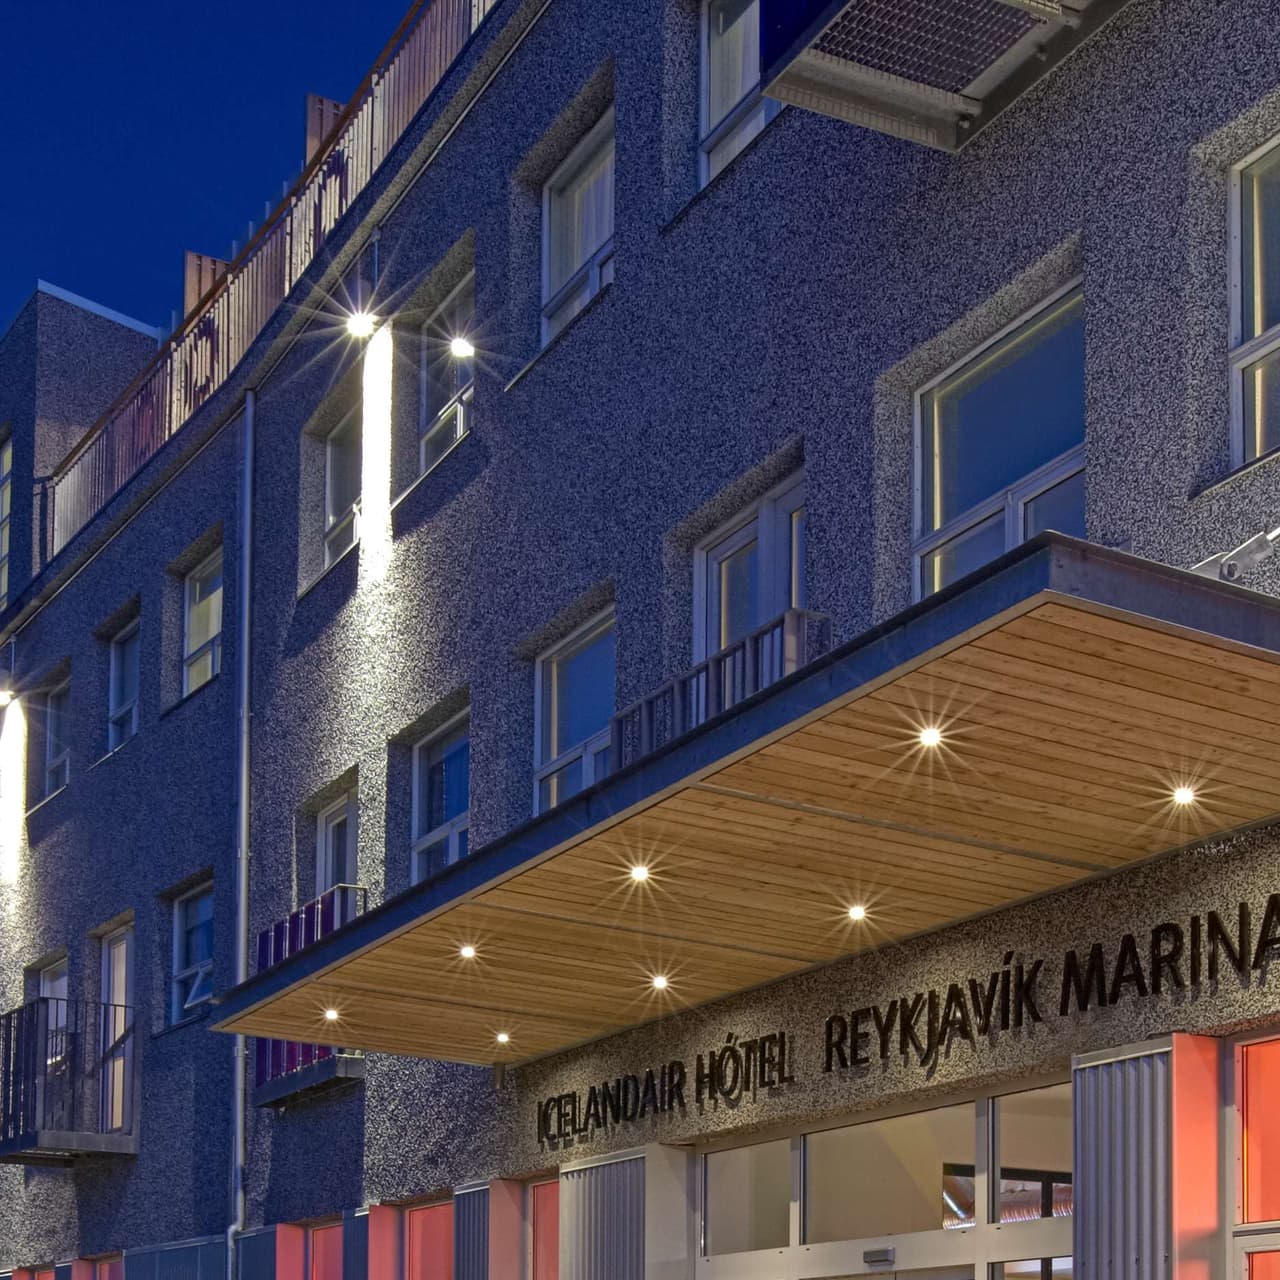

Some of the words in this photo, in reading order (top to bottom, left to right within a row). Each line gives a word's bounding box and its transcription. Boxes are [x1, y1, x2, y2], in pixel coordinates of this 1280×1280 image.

[537, 1060, 687, 1144] ICELANDAIR
[695, 1032, 794, 1107] HÓTEL
[824, 951, 1043, 1073] REYKJAVÍK
